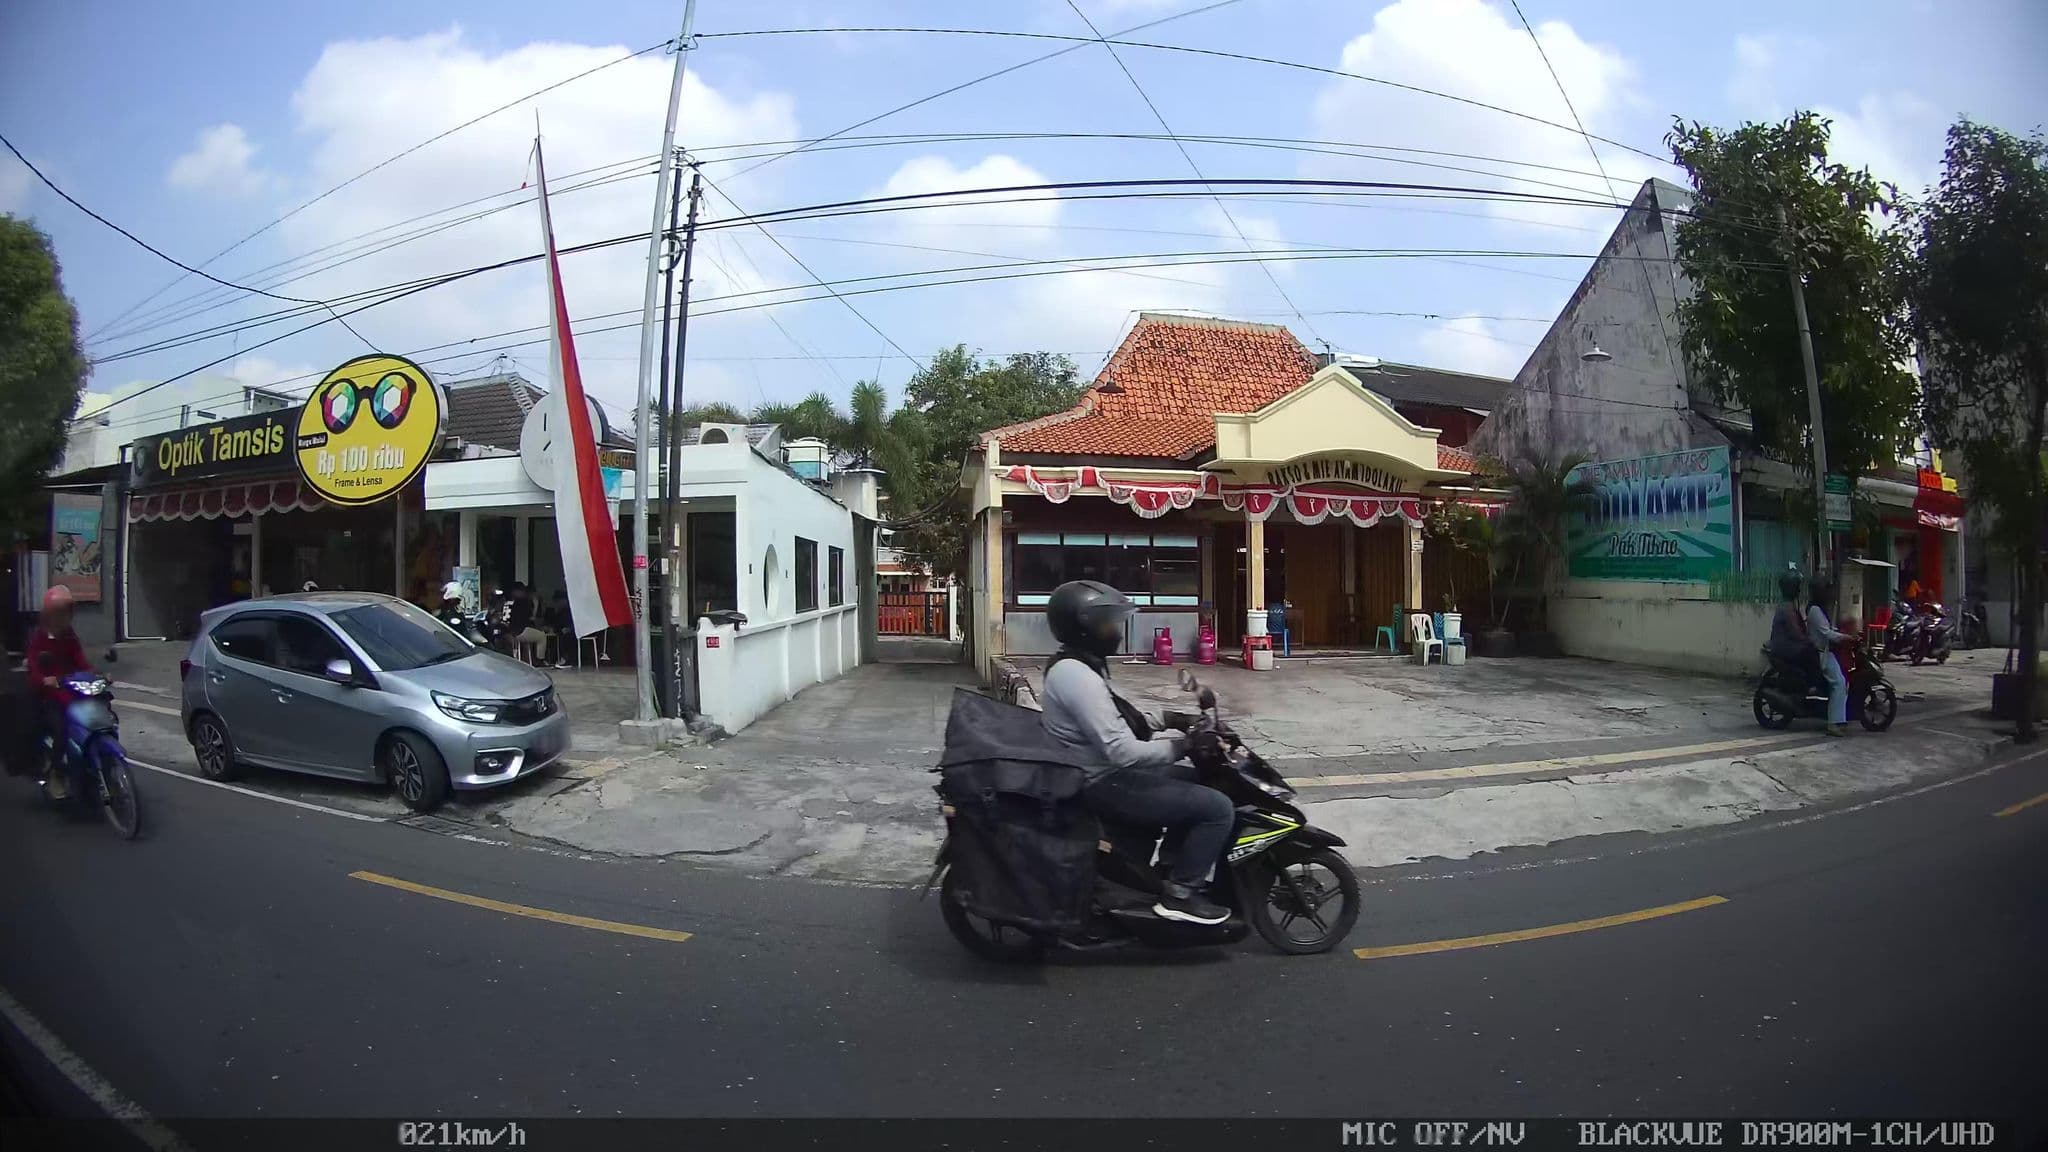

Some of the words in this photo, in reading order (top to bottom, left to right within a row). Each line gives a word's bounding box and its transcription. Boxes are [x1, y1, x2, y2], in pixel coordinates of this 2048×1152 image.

[158, 430, 204, 476] Optik
[210, 417, 284, 461] Tamsis
[318, 450, 336, 479] Rp
[341, 446, 368, 472] 100
[374, 443, 405, 470] ribu
[1267, 463, 1302, 486] BAKSO
[1312, 459, 1330, 479] MIE
[1333, 460, 1359, 481] AYAM
[334, 478, 354, 488] Frame
[355, 478, 361, 486] &
[362, 476, 383, 486] Lensa
[1609, 532, 1635, 556] Pak
